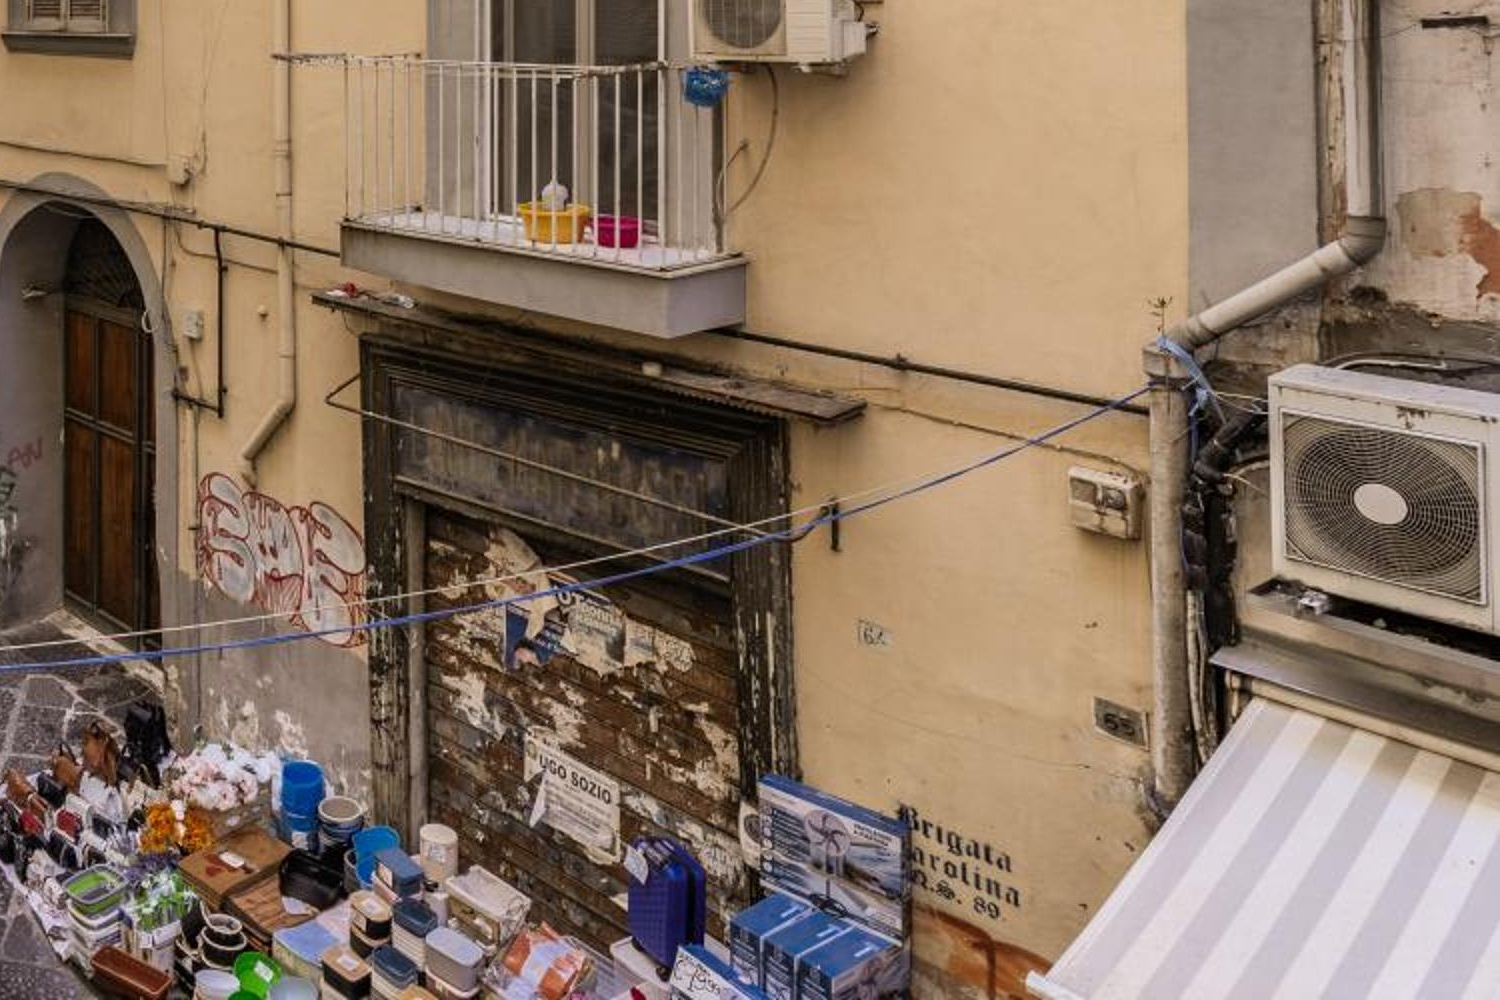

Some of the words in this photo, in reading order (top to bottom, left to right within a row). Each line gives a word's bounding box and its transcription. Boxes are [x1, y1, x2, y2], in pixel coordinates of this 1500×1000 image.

[539, 754, 567, 780] UGO
[570, 770, 612, 805] SOZIO
[910, 846, 1021, 908] arolina
[973, 895, 1000, 920] 89
